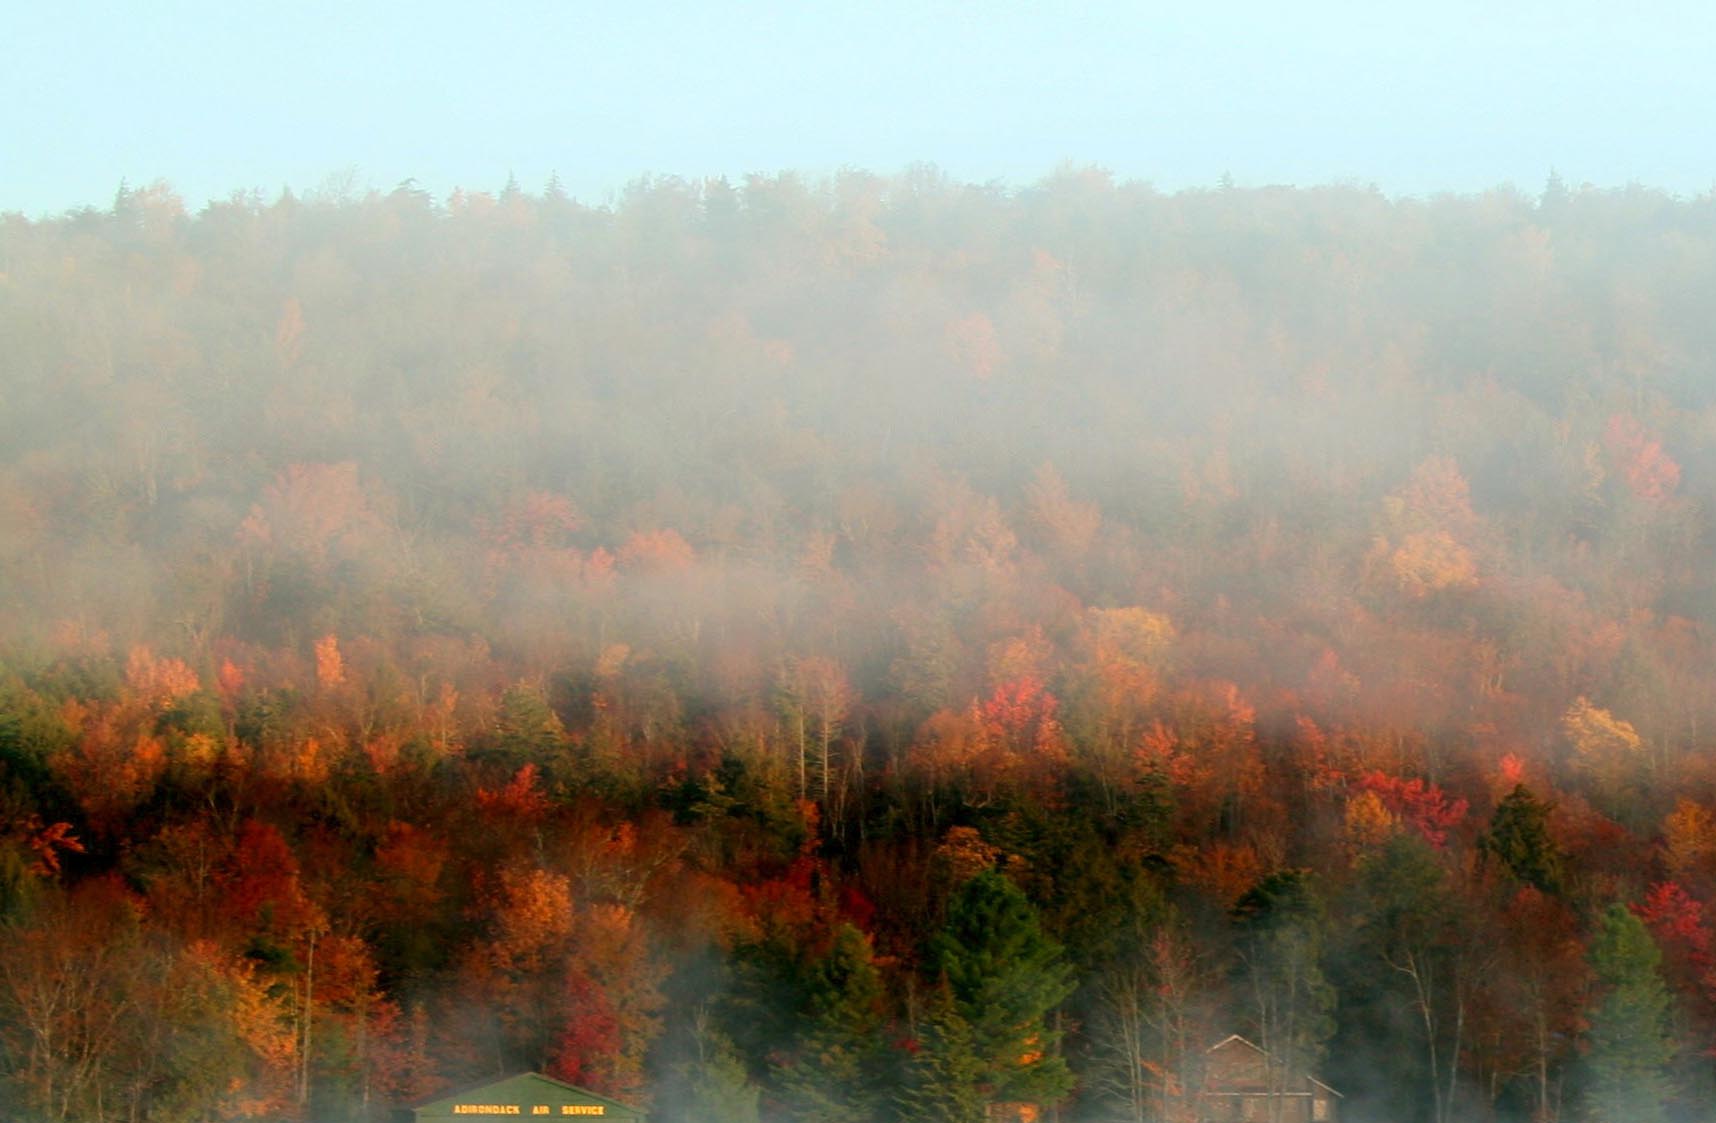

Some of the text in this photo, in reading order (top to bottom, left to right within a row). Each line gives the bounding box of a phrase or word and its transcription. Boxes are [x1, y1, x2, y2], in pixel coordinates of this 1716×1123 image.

[453, 1104, 605, 1116] ADIRONDACK AIR SERVICE
